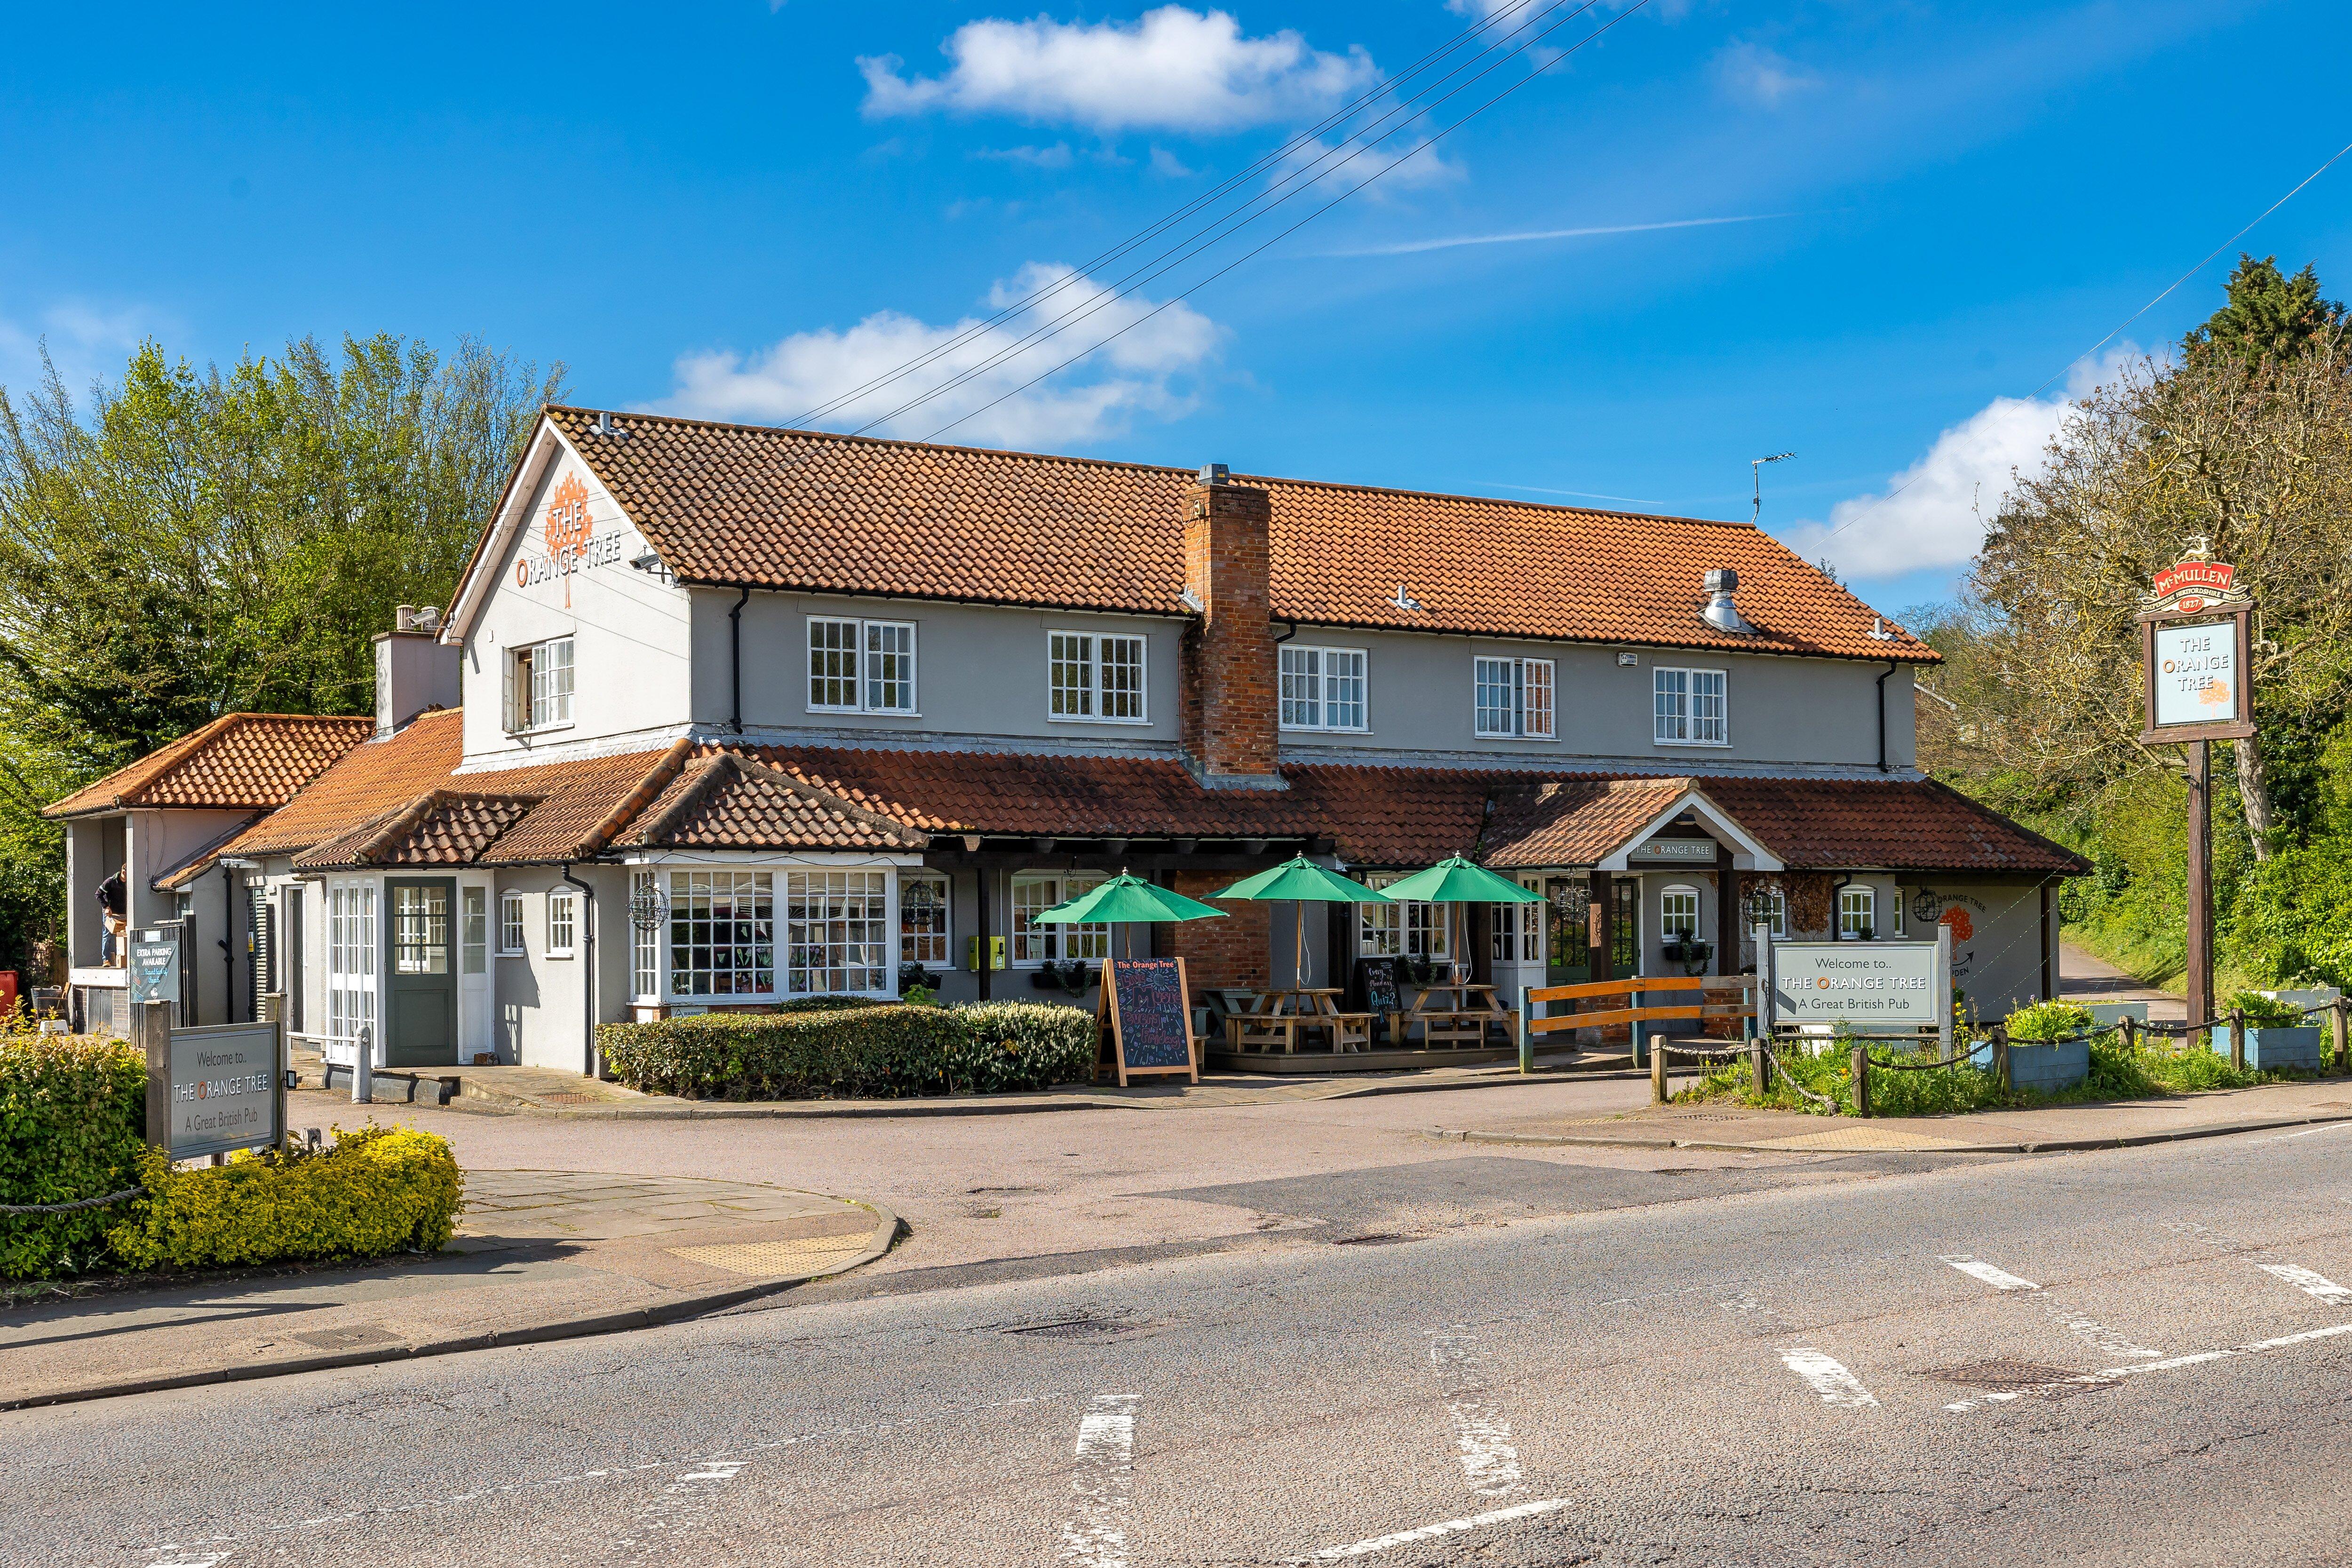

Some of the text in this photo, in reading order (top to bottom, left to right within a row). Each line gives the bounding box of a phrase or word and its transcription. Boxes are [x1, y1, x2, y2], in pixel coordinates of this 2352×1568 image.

[553, 500, 582, 537] THE
[516, 530, 621, 588] ORANGE TREE
[2141, 588, 2248, 611] INDEPENDENT HERTFORDSHIRE BREWERS
[2180, 637, 2210, 653] THE
[2163, 654, 2229, 674] ORANGE
[2177, 675, 2214, 691] TREE
[1636, 844, 1709, 855] THE ORANGE TREE
[1970, 897, 1987, 913] TREE
[136, 947, 172, 957] EXTRA PARKING
[142, 957, 166, 966] AVAILABLE
[1133, 961, 1157, 970] Orange
[1815, 958, 1892, 969] Welcome to..
[1781, 976, 1926, 990] THE ORANGE TREE
[1798, 997, 1910, 1009] A Great British Pub
[1141, 1027, 1181, 1050] Friday
[197, 1051, 247, 1068] Welcome to..
[174, 1074, 268, 1103] THE ORANGE TREE
[185, 1106, 258, 1133] A Great British Pub
